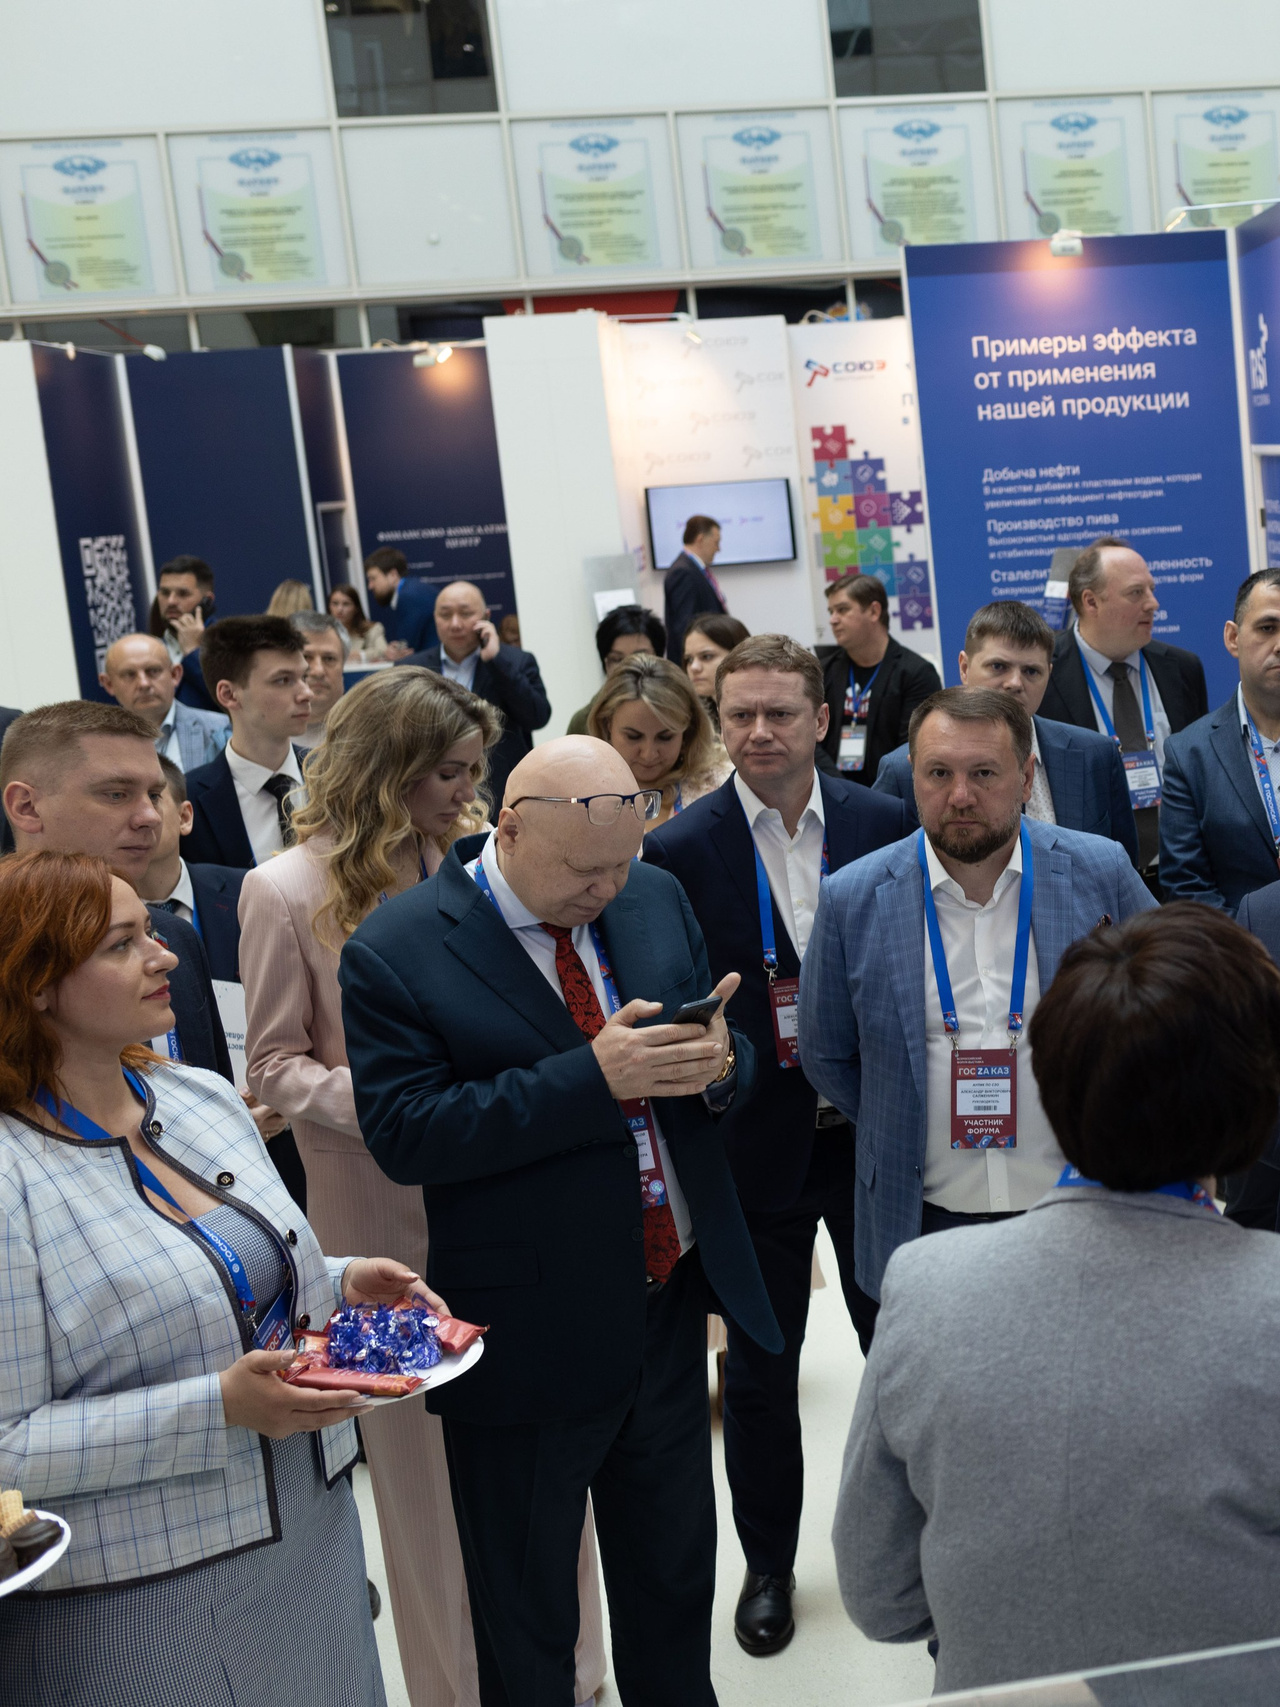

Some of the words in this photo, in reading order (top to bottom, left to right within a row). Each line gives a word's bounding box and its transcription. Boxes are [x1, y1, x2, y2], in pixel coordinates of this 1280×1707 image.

[971, 334, 1087, 363] Примеры
[1093, 326, 1198, 355] эффекта
[974, 371, 1001, 390] от
[1008, 362, 1156, 392] применения
[977, 395, 1055, 421] нашей
[1062, 391, 1190, 420] продукции
[982, 468, 1036, 483] Добыча
[1039, 464, 1080, 478] нефти
[987, 517, 1084, 534] Производство
[1086, 513, 1119, 526] пива
[991, 568, 1051, 583] Сталелит
